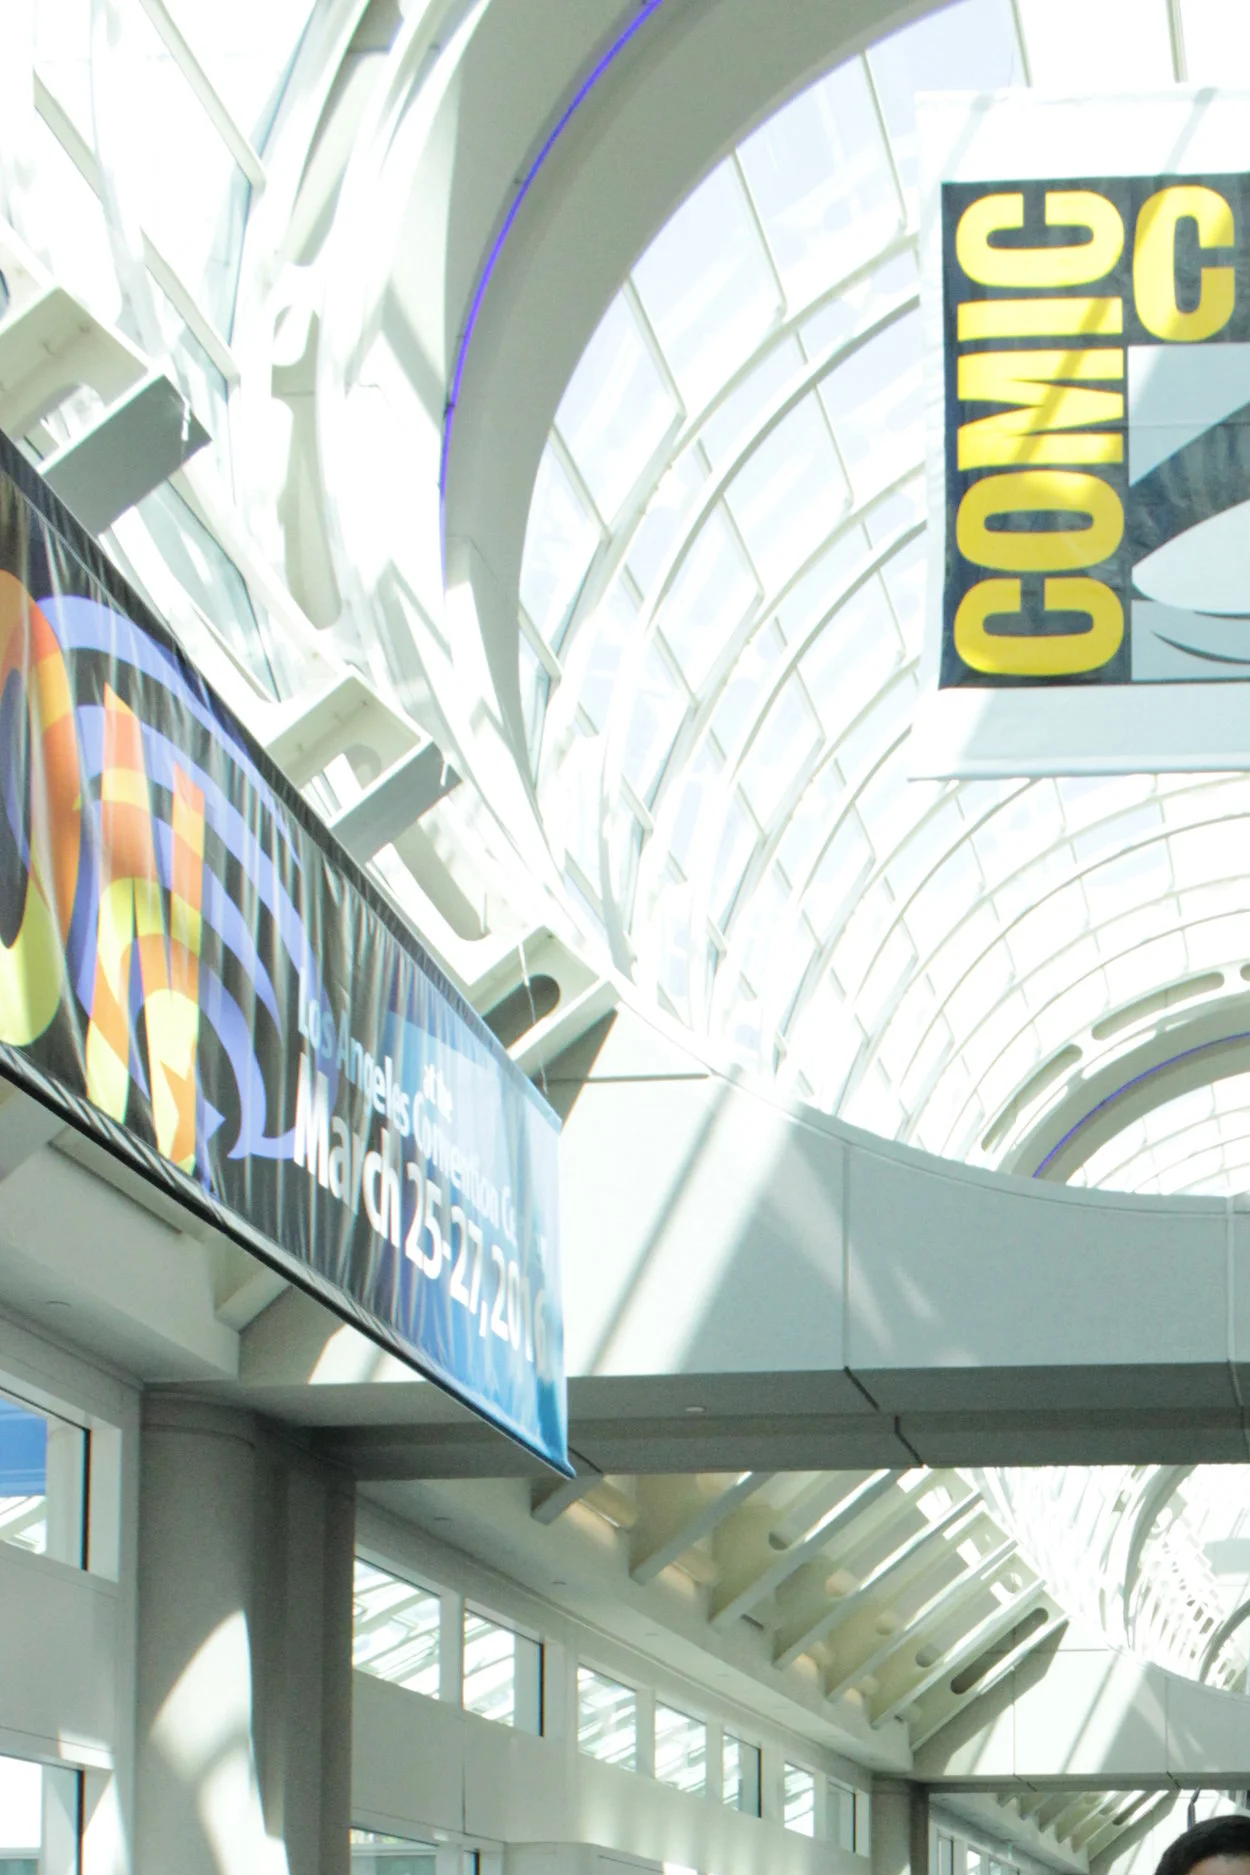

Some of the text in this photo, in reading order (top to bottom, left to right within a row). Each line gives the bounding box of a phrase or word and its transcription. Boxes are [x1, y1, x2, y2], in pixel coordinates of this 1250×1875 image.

[953, 189, 1125, 676] COMIC
[293, 1051, 400, 1248] March
[299, 968, 502, 1231] Los Angeles Convention
